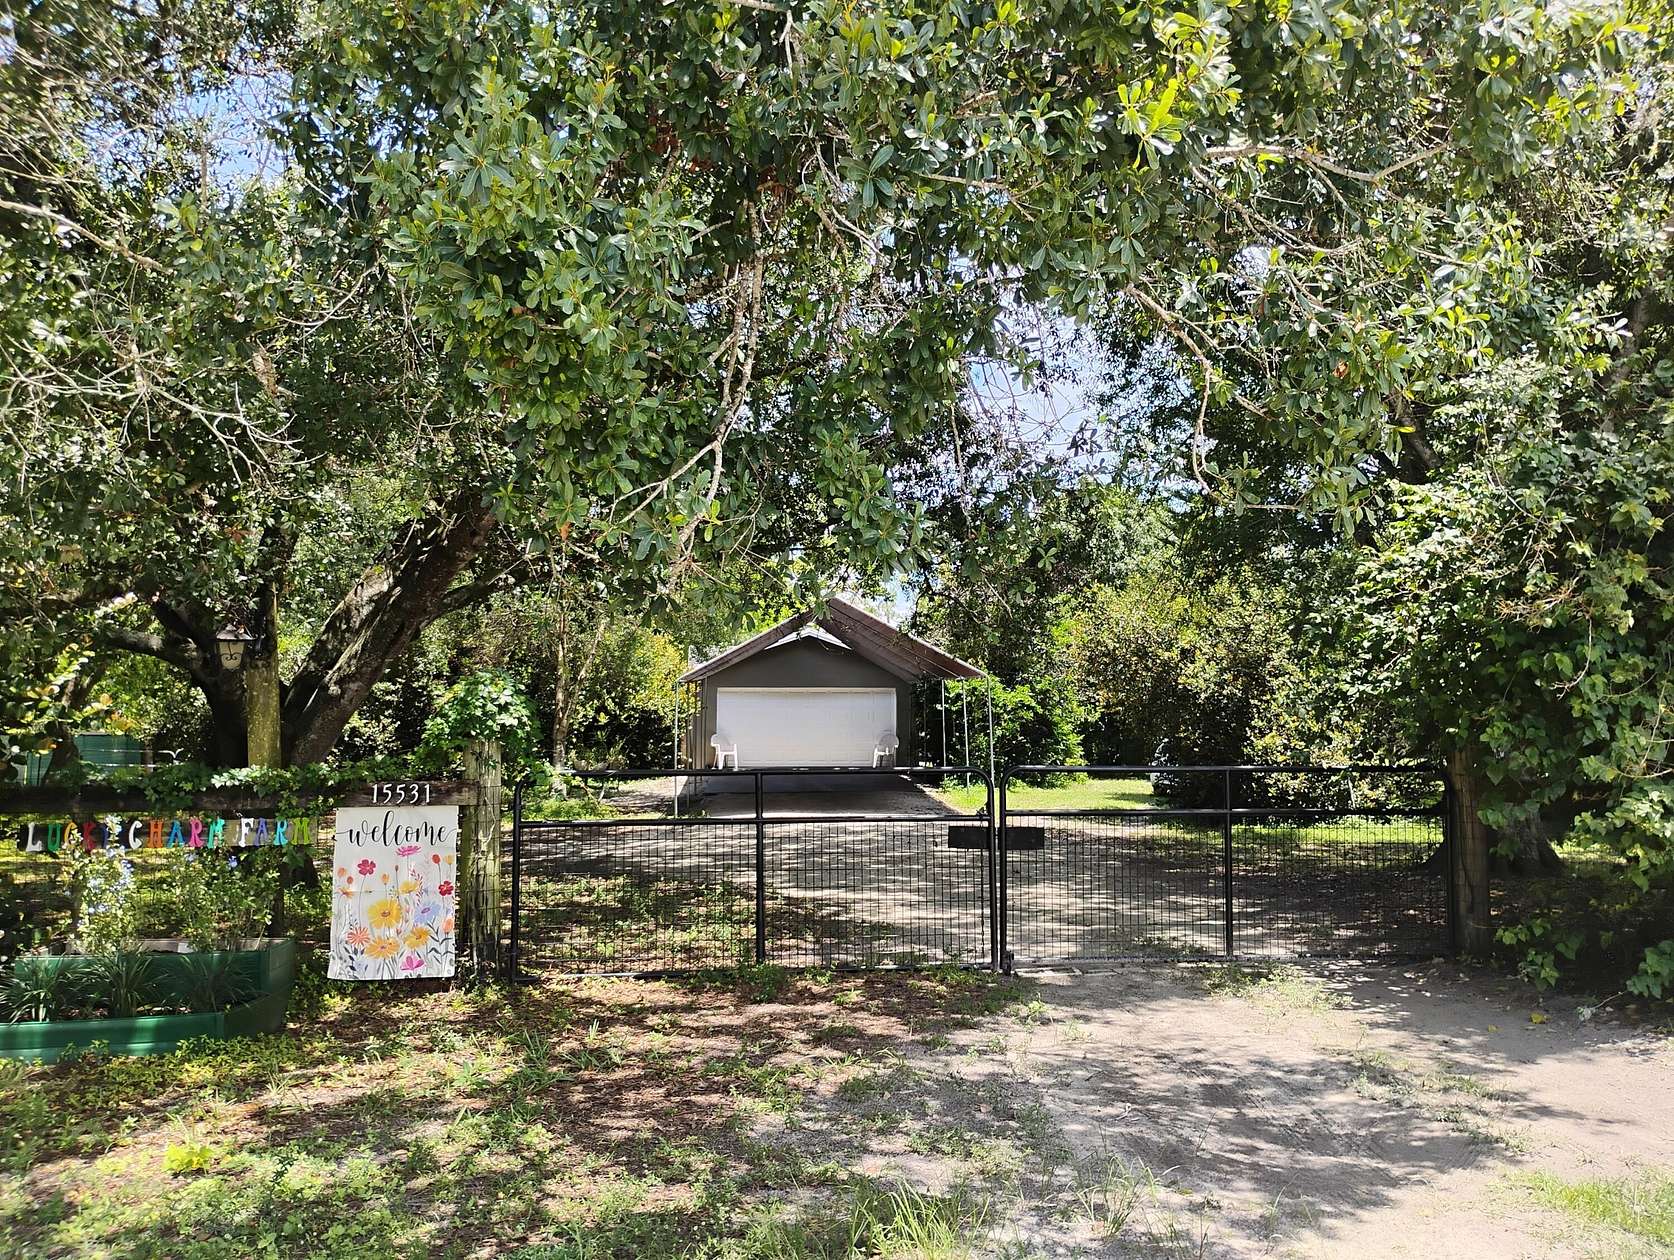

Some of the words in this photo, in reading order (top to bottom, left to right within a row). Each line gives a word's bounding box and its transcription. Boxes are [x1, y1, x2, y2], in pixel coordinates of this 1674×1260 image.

[371, 782, 431, 804] 15531
[25, 820, 119, 852] LUCK
[128, 816, 225, 849] CHARM
[238, 817, 310, 847] FARM
[336, 810, 457, 847] welcome
